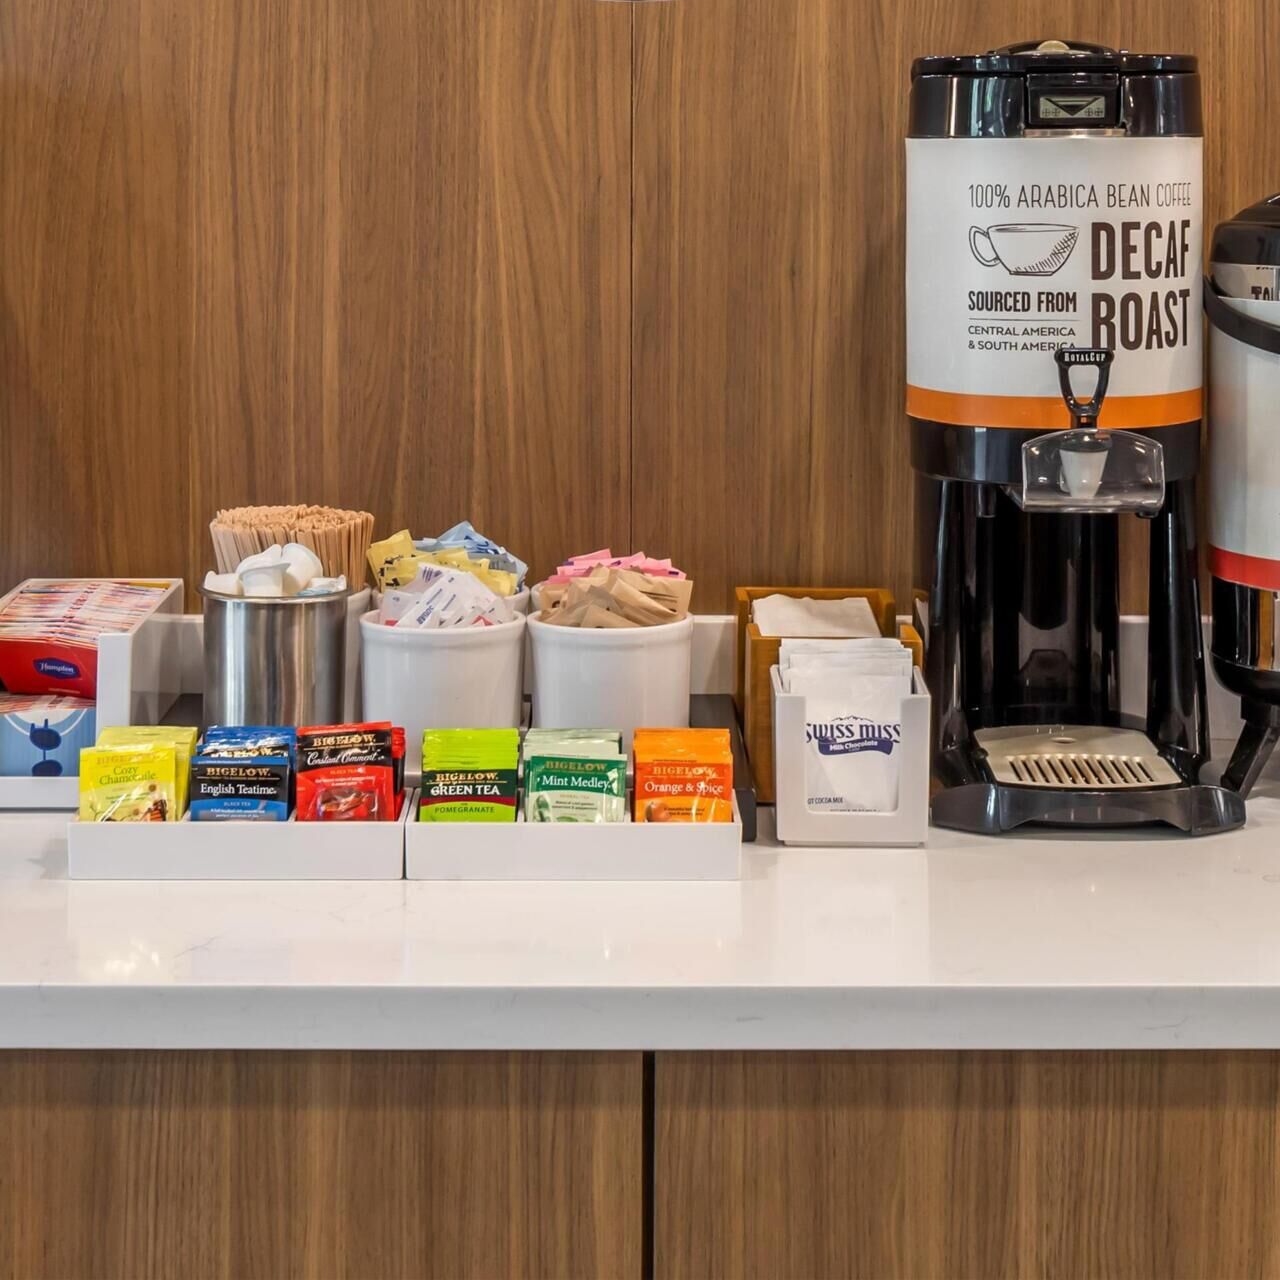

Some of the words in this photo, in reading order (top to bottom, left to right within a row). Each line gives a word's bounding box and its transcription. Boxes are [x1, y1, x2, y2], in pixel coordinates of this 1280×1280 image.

[968, 184, 1011, 208] 100%
[1017, 184, 1099, 208] ARABICA
[1107, 184, 1150, 208] BEAN
[1156, 182, 1192, 207] COFFEE
[1091, 219, 1191, 281] DECAF
[968, 291, 1031, 313] SOURCED
[1037, 291, 1077, 313] FROM
[1091, 288, 1191, 351] ROAST
[968, 325, 1020, 336] CENTRAL
[1021, 327, 1076, 337] AMERICA
[968, 340, 975, 350] &
[977, 340, 1018, 351] SOUTH
[829, 743, 845, 752] Milk
[845, 740, 878, 750] Chocolate
[541, 775, 568, 787] Mint
[200, 783, 235, 796] English
[430, 784, 473, 796] GREEN
[475, 784, 500, 796] TEA
[644, 781, 683, 795] Orange
[685, 783, 694, 792] &
[435, 806, 495, 814] POMEGRANATE
